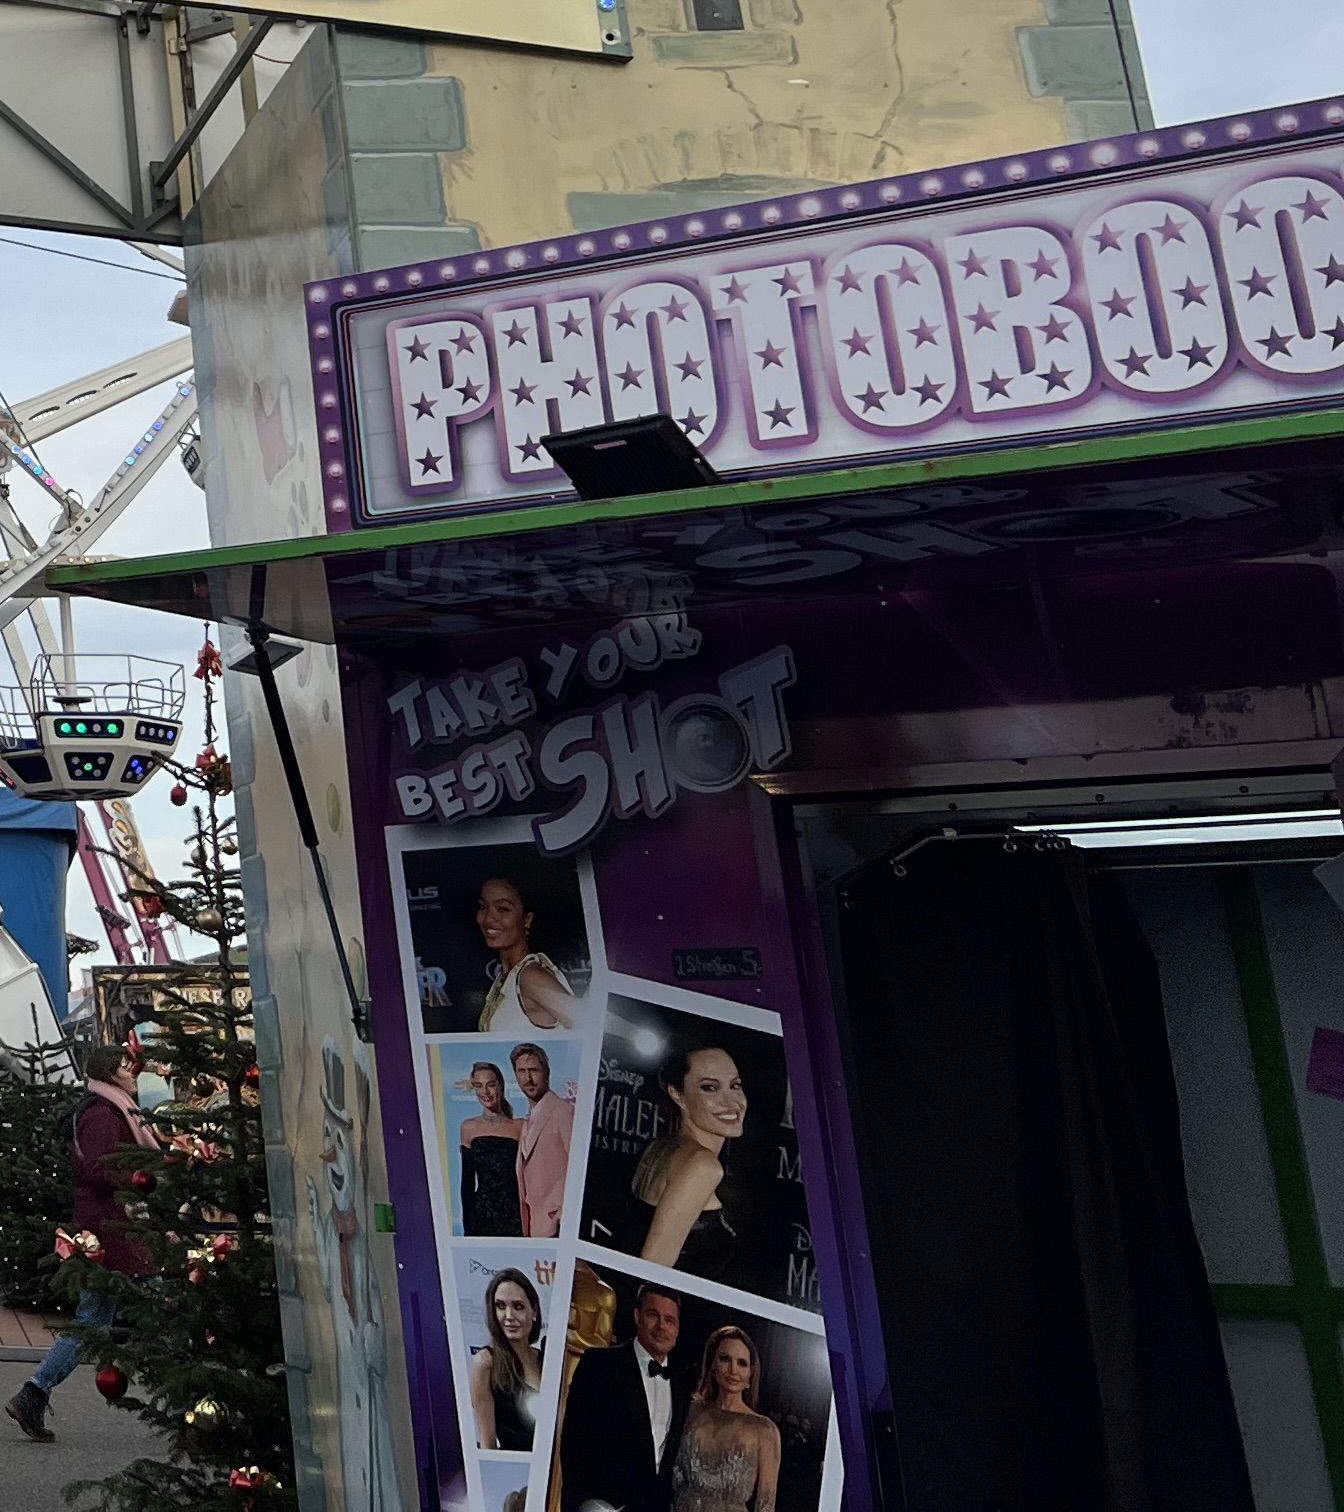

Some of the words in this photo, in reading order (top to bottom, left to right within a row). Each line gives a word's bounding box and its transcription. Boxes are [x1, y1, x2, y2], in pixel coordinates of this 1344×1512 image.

[388, 660, 534, 749] TAKE
[540, 612, 701, 699] YOUR
[396, 735, 531, 820] BEST
[535, 646, 796, 854] SHOT
